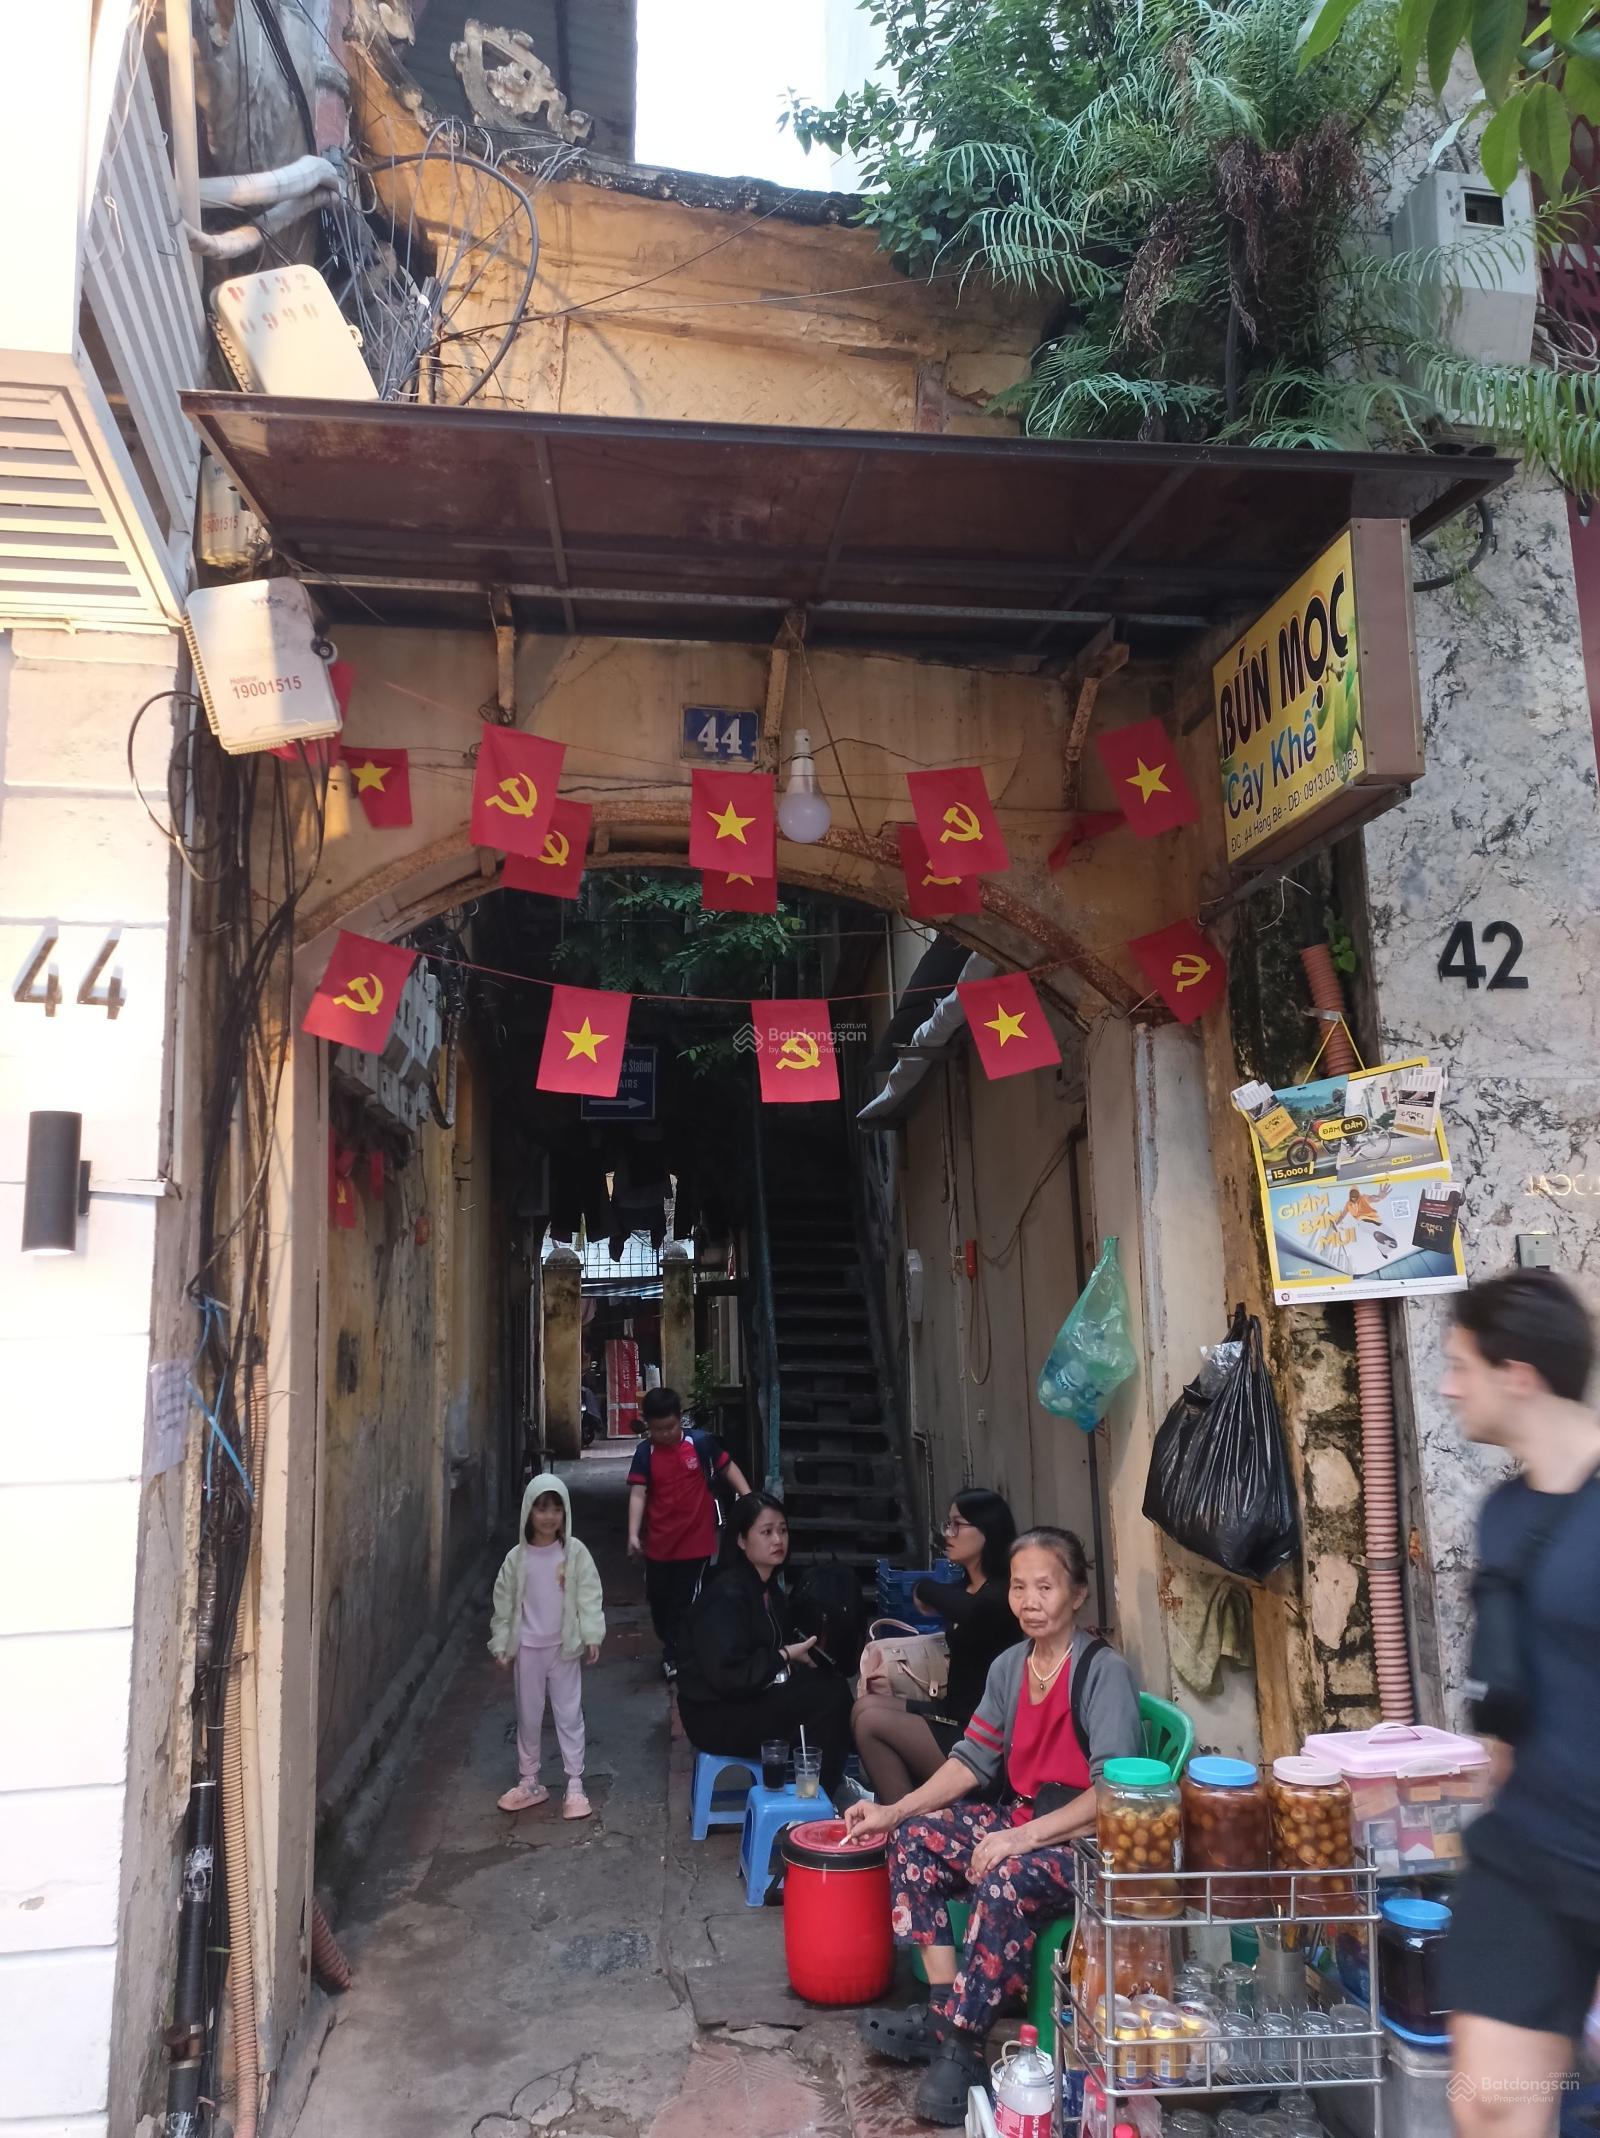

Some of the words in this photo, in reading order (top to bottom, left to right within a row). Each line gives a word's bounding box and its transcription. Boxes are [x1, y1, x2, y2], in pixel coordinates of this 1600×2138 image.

[231, 675, 303, 700] 19001515
[1220, 645, 1272, 761] BÚN
[1278, 571, 1349, 709] MỌC
[697, 716, 743, 754] 44
[1227, 762, 1264, 819] Cây
[1270, 695, 1317, 788] Khế
[12, 918, 127, 1020] 44
[1438, 921, 1529, 991] 42
